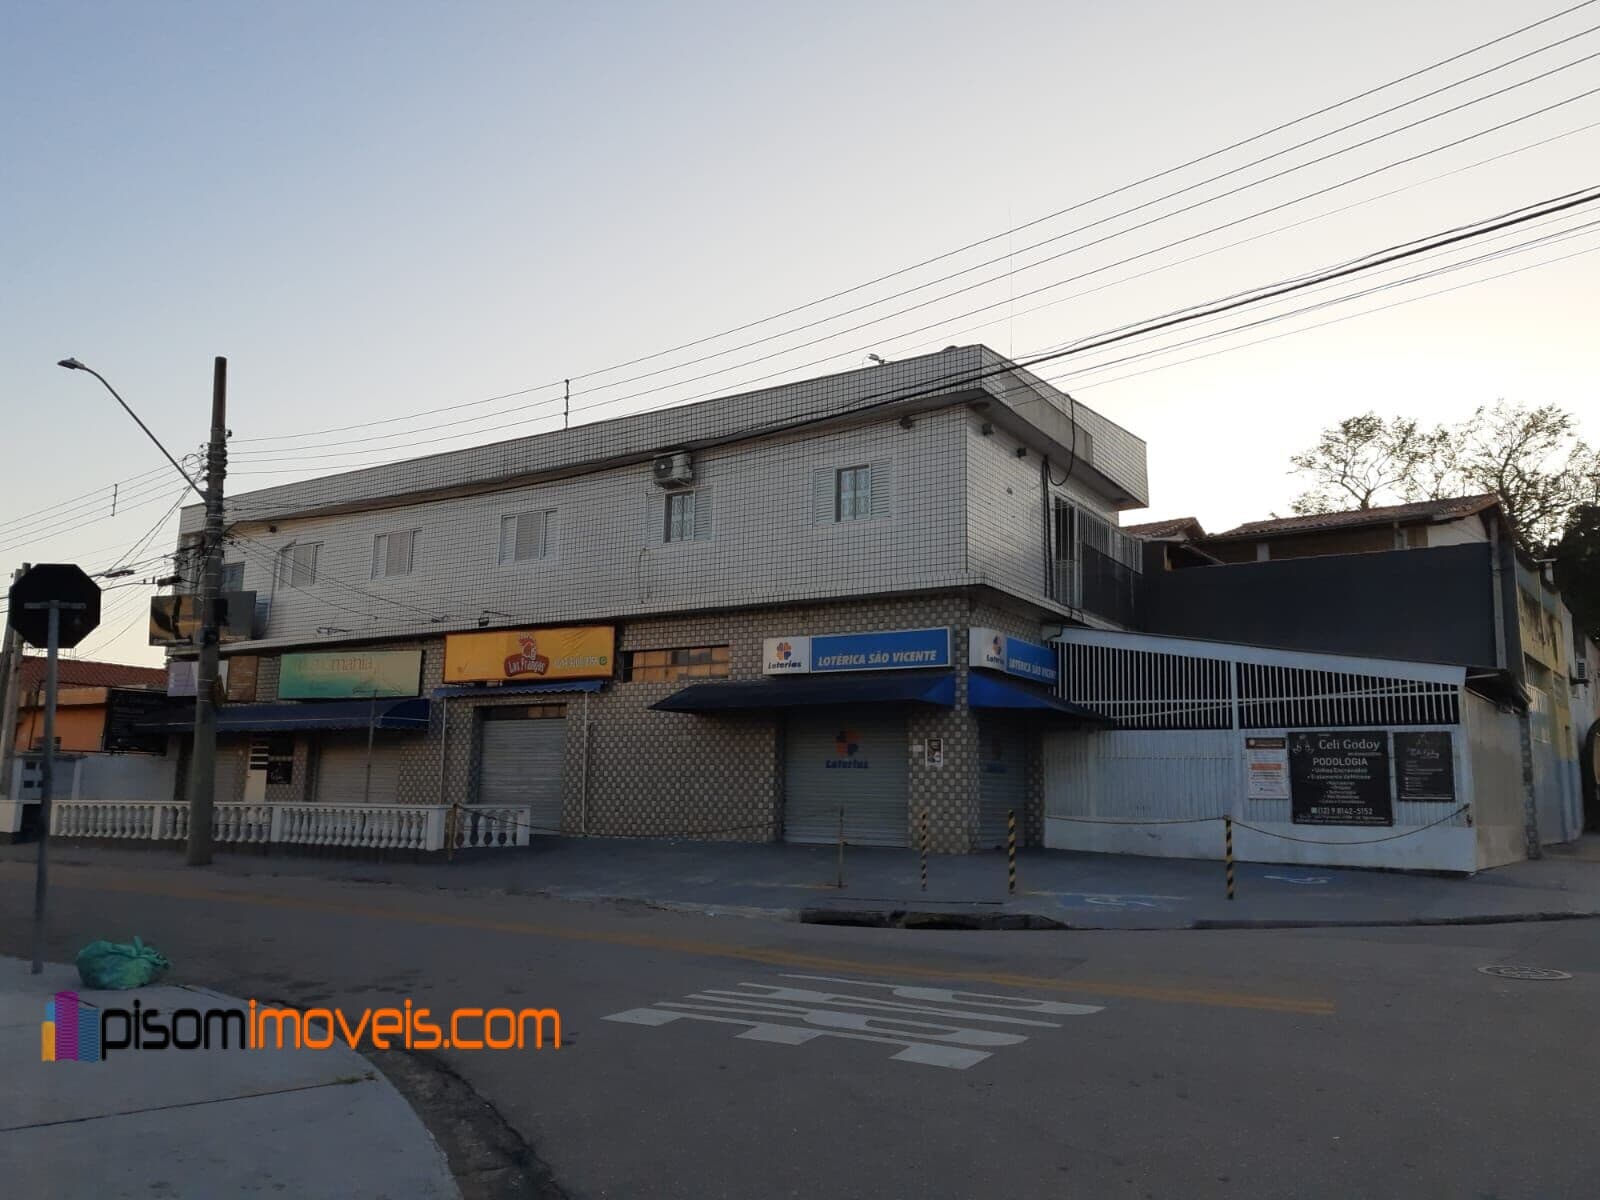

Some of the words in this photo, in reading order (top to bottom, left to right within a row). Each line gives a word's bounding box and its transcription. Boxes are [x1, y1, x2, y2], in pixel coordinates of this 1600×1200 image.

[818, 652, 866, 667] LOTÉRICA
[868, 650, 889, 664] SÃO
[892, 650, 938, 663] VICENTE
[768, 660, 802, 670] Loterias
[1319, 738, 1340, 750] Celi
[1343, 738, 1381, 752] Godoy
[1312, 757, 1368, 767] PODOLOGIA
